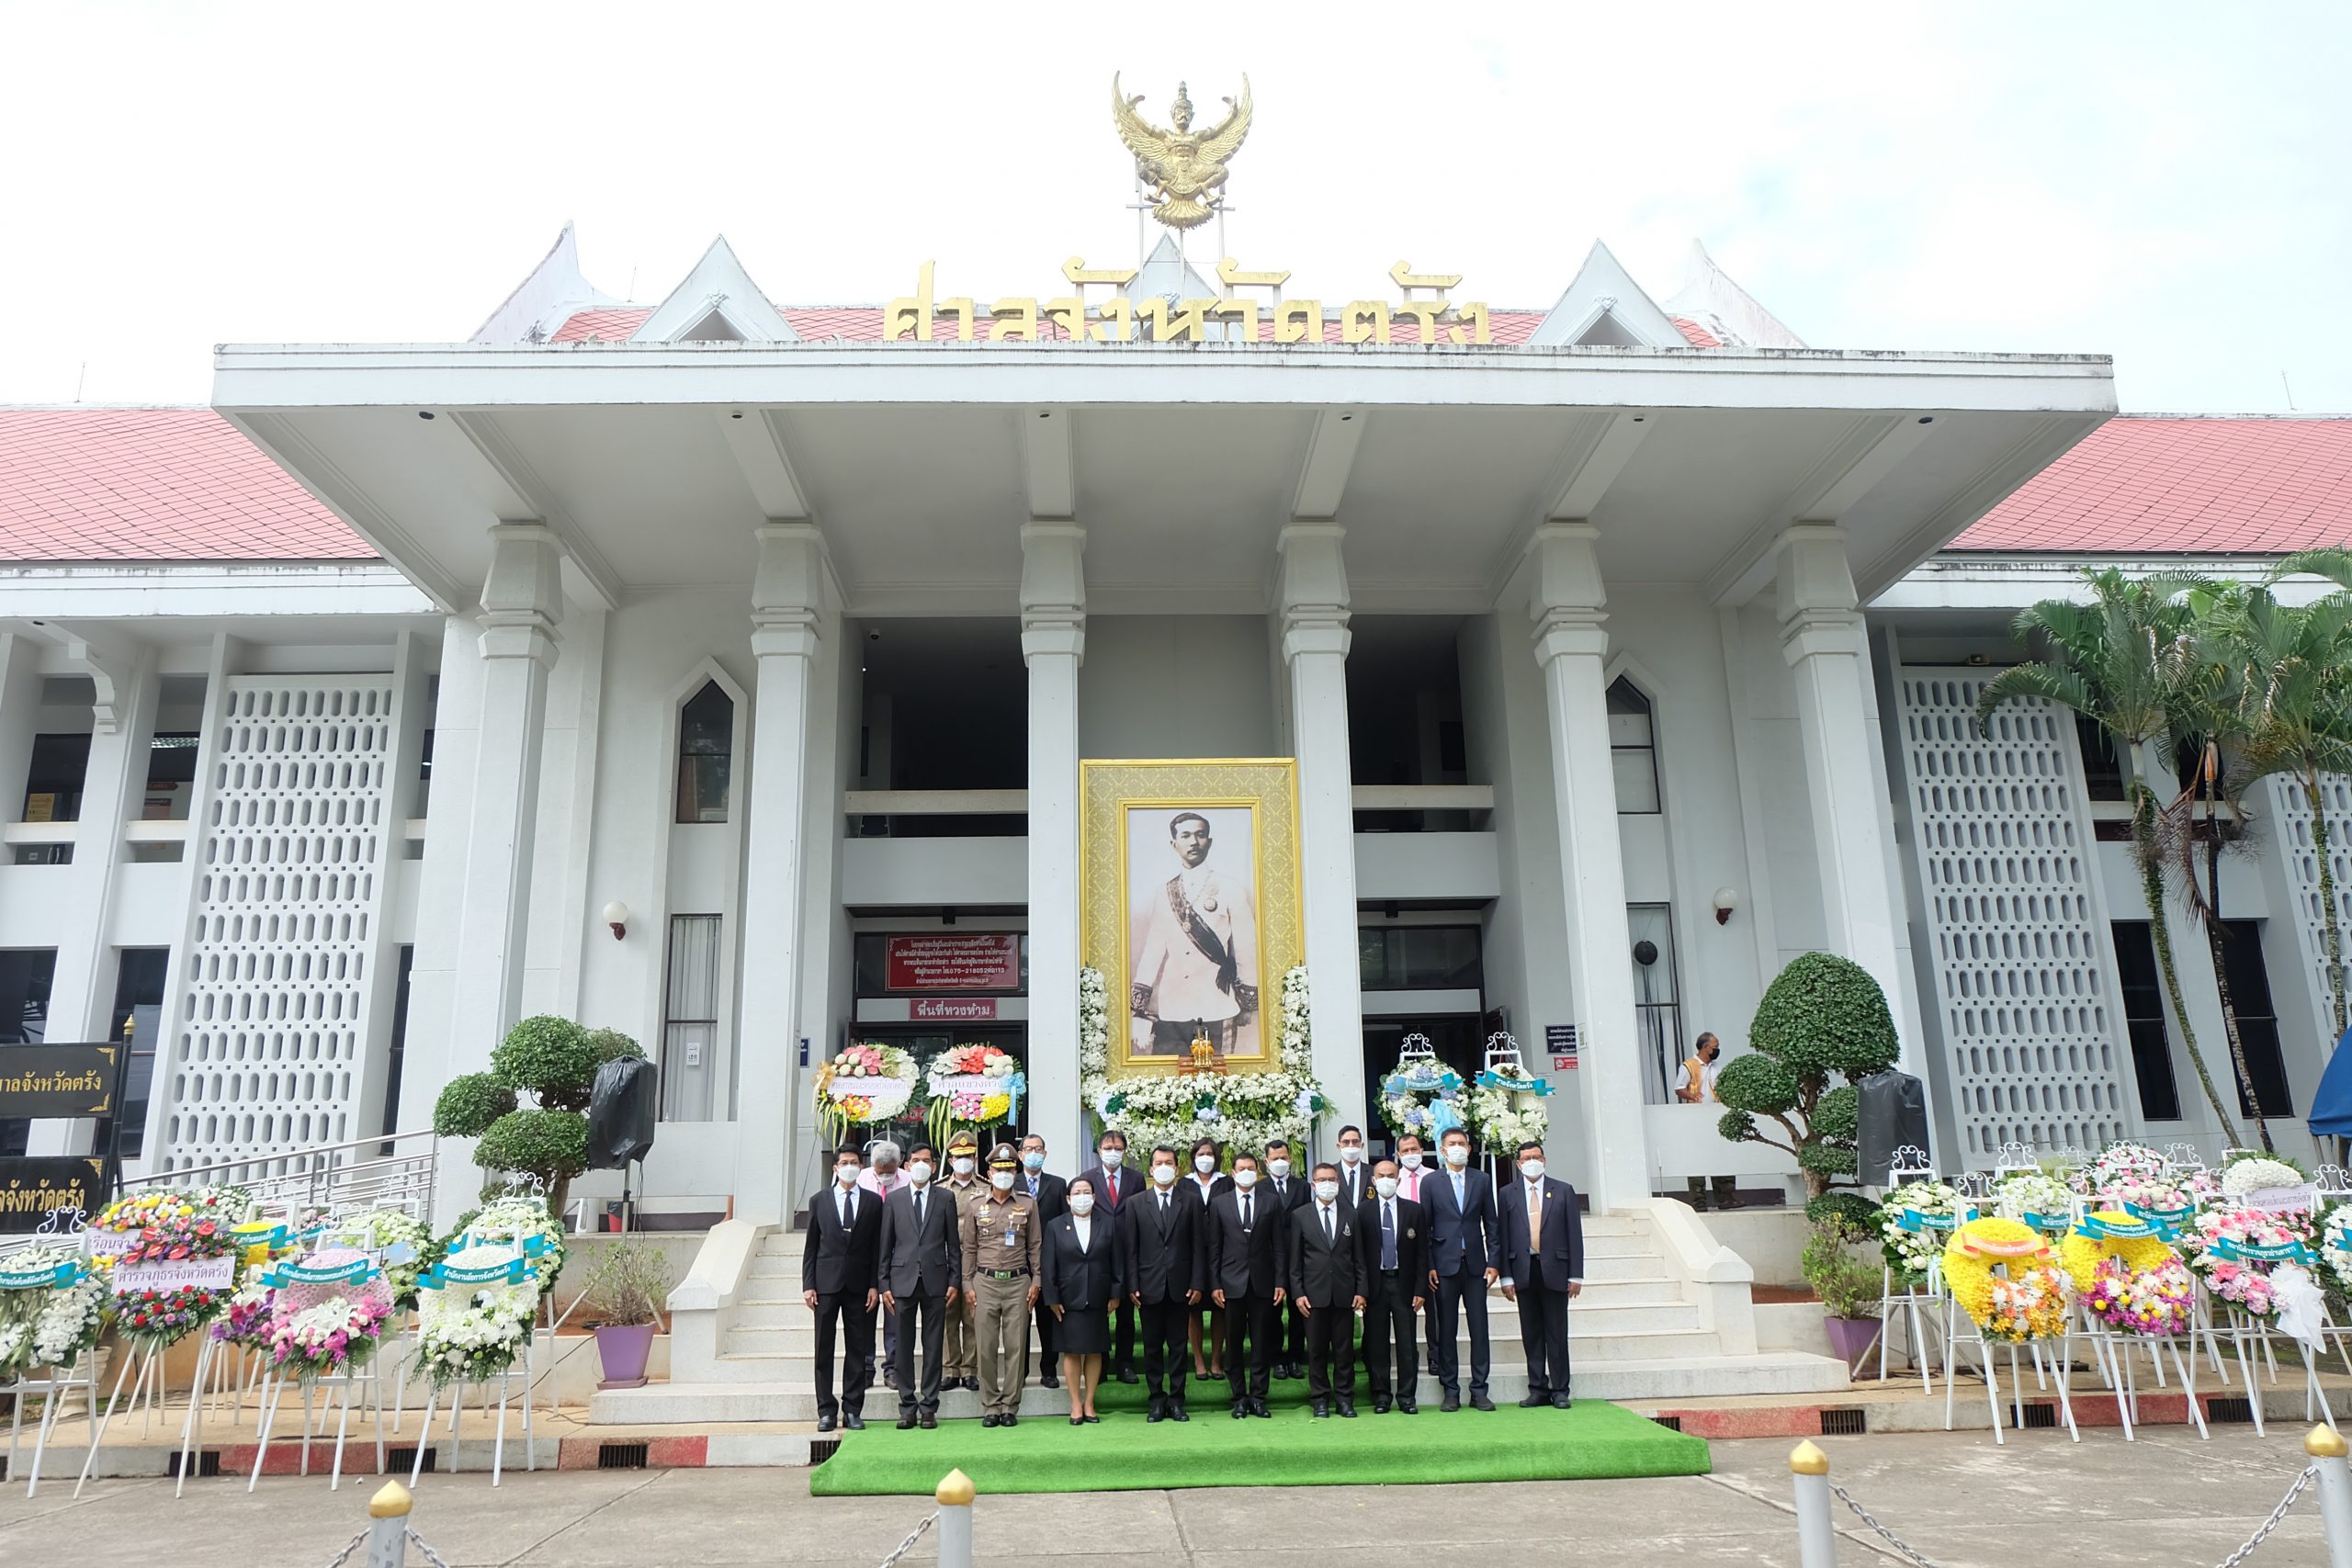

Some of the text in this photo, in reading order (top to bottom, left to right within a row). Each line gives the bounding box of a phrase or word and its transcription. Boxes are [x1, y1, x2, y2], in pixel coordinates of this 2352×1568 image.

[883, 256, 1490, 344] ศาลจังหวัดตรัง
[918, 1000, 989, 1016] พื้นที่หวงห้าม
[0, 1070, 101, 1093] าลจังหวัดตรัง
[118, 1263, 229, 1286] ตำรวจภูธรจังหวัดตรัง
